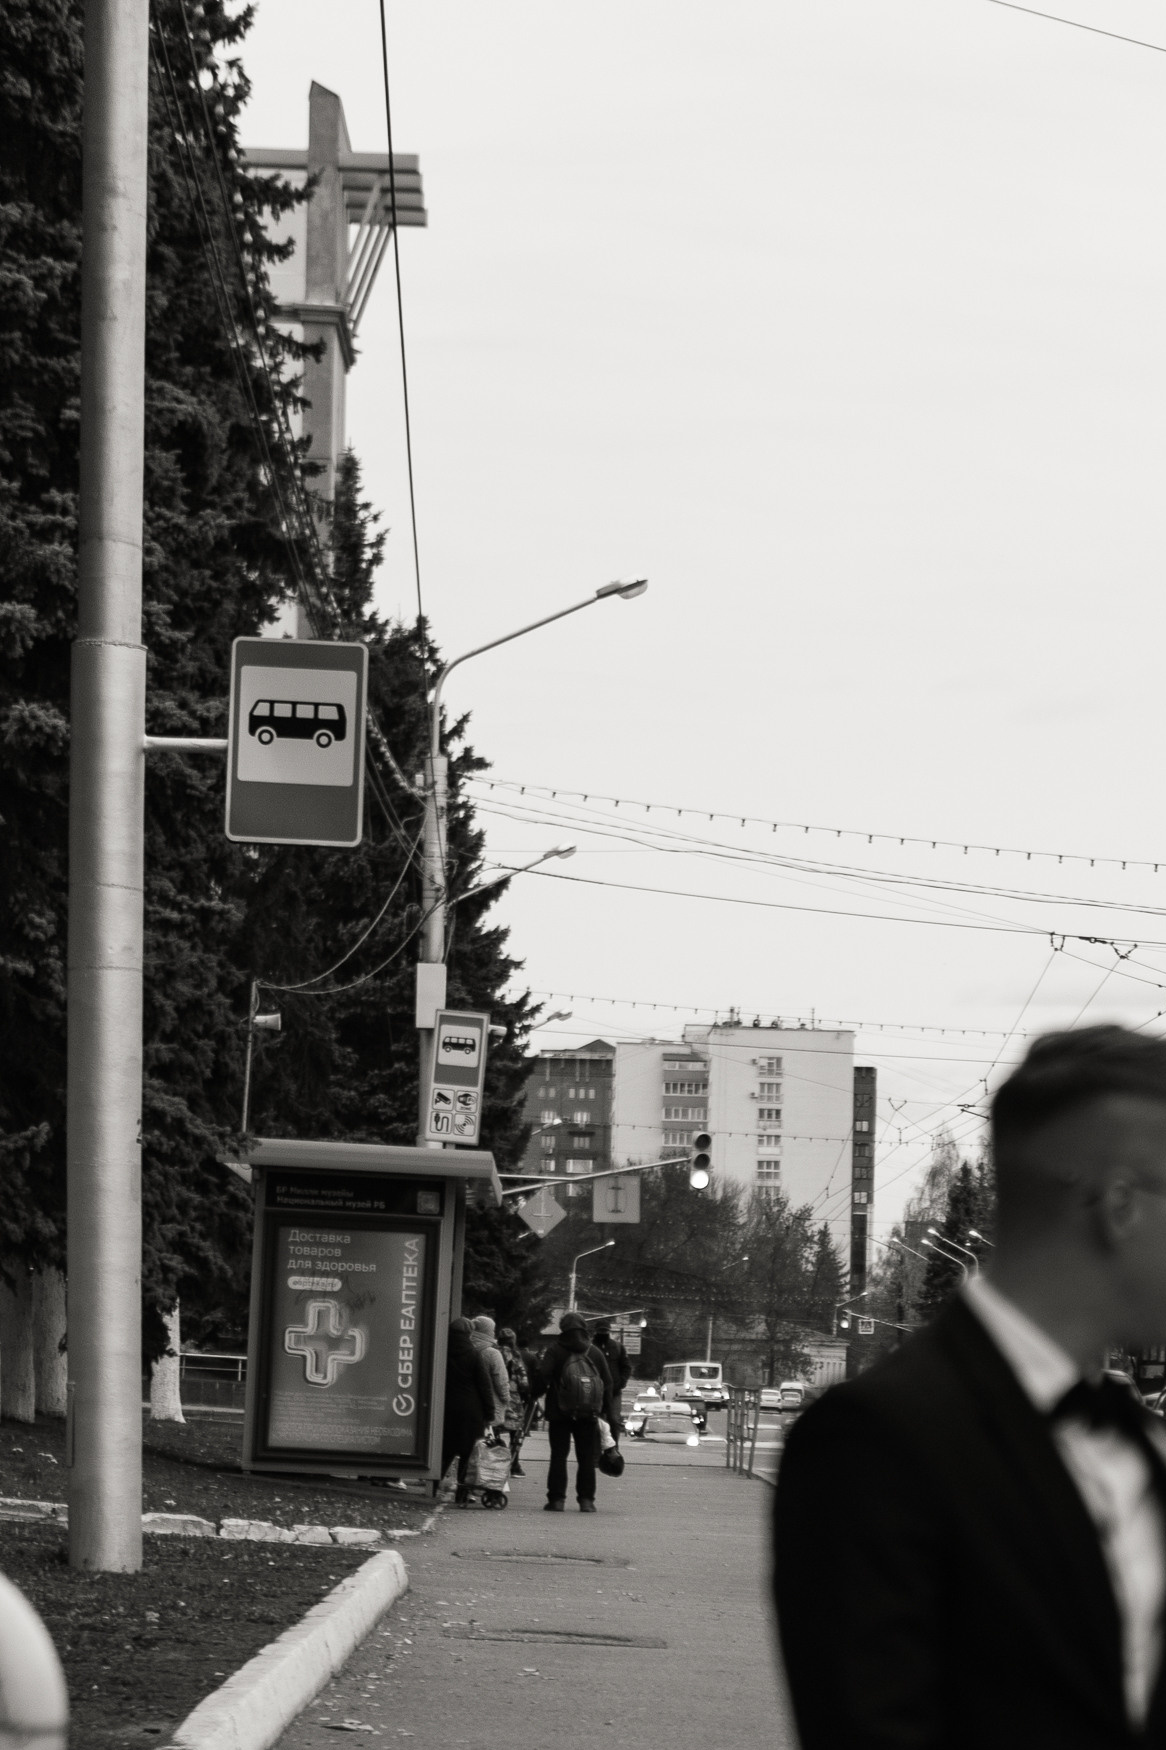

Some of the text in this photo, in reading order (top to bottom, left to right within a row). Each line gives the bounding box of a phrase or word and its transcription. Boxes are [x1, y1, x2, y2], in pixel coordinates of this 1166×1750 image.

[276, 1195, 386, 1210] Национальный музей РБ
[288, 1229, 351, 1244] Доставка
[288, 1246, 342, 1258] товаров
[287, 1259, 377, 1273] для здоровья
[398, 1238, 419, 1388] СБЕР ЕАПТЕКА
